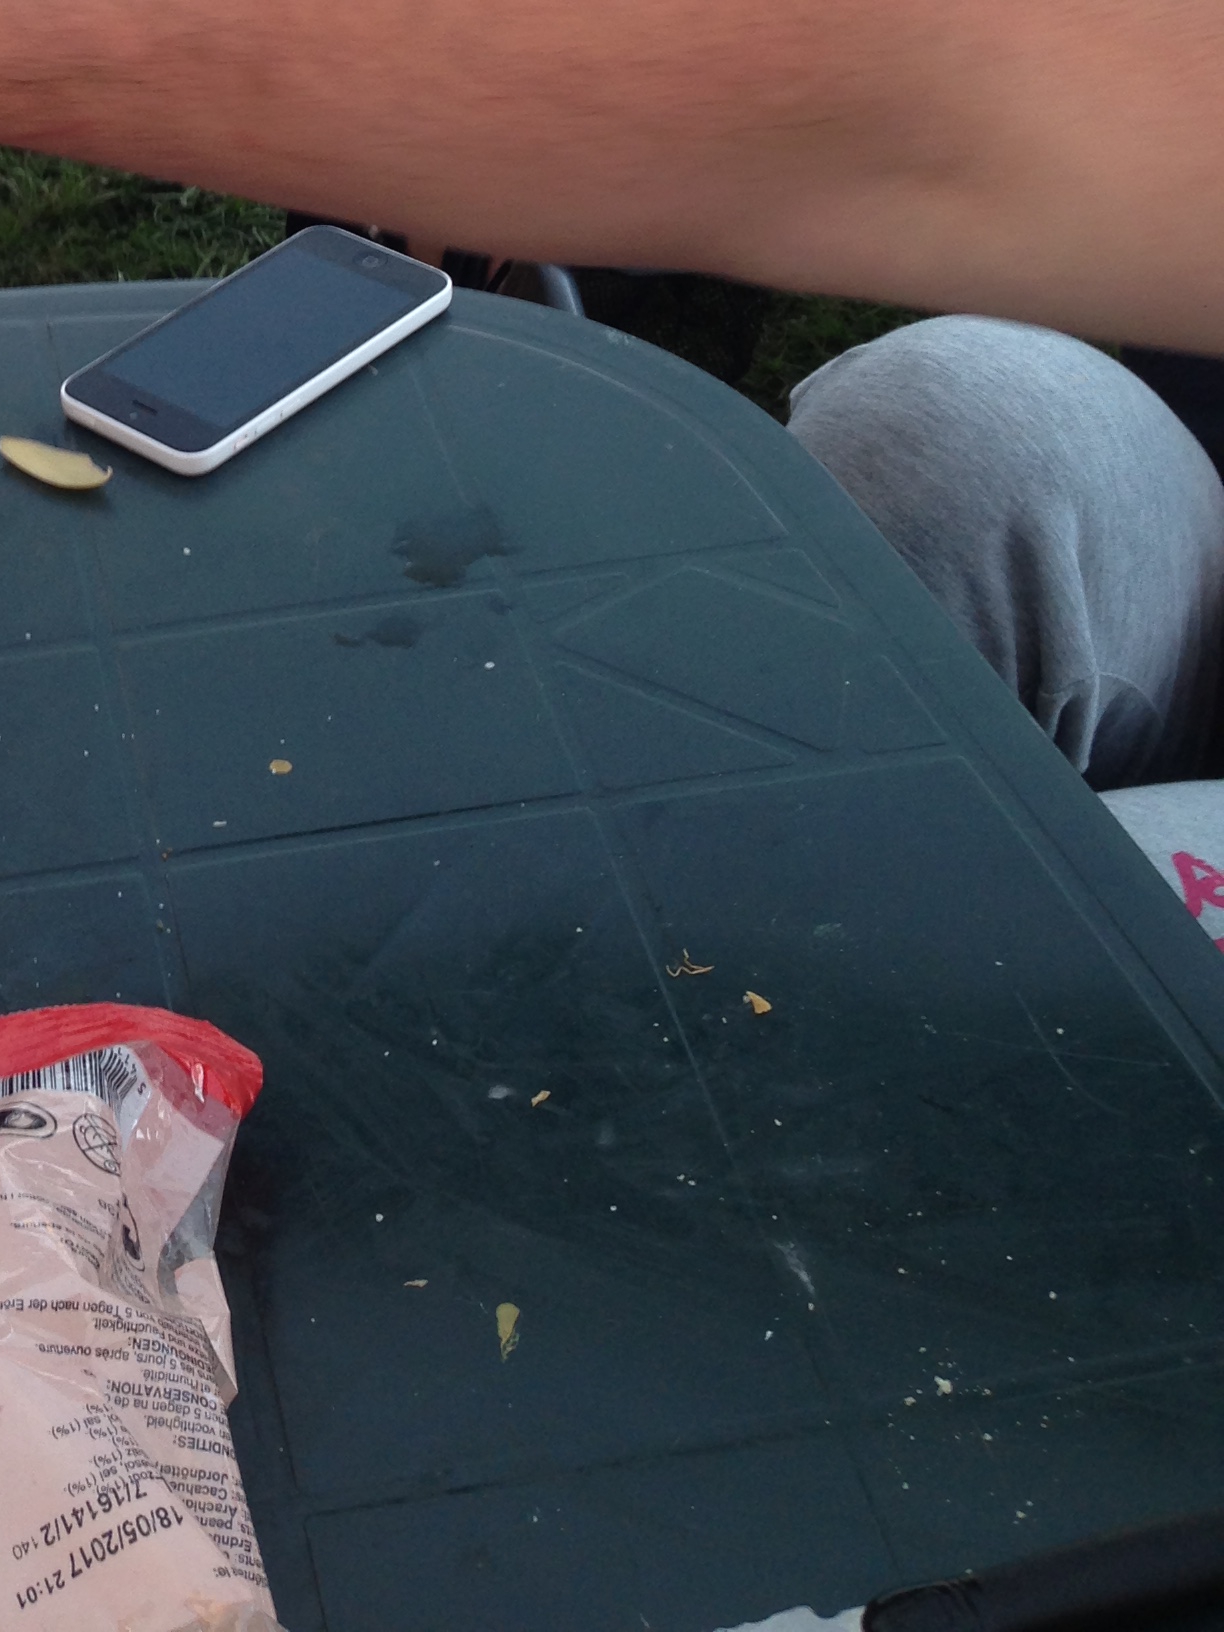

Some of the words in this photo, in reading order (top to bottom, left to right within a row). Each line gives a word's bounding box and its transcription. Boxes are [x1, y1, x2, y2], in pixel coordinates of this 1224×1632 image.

[28, 1299, 48, 1313] der
[51, 1300, 80, 1312] nach
[82, 1300, 121, 1320] Tagen
[95, 1347, 130, 1362] après
[106, 1380, 217, 1411] CONSERVATION:
[114, 1396, 129, 1409] de
[134, 1399, 148, 1410] na
[152, 1399, 191, 1417] dagen
[69, 1506, 183, 1579] 18/05/2017
[16, 1570, 65, 1609] 21:01
